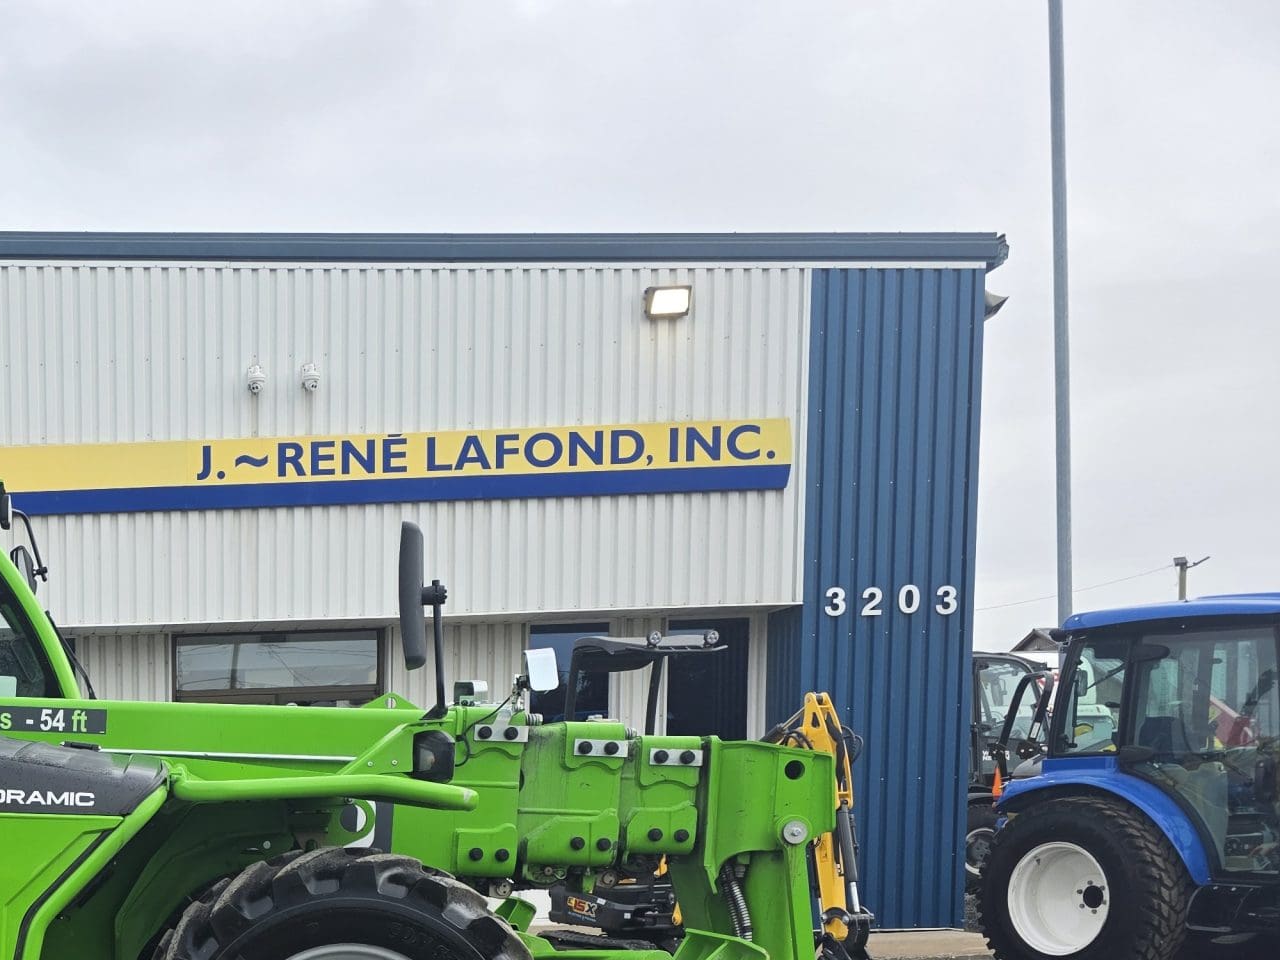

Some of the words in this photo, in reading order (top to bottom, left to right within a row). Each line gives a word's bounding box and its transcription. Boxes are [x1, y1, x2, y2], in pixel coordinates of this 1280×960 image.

[427, 428, 653, 472] LAFOND,
[669, 423, 776, 462] INC.
[40, 709, 65, 732] 54
[71, 710, 88, 732] ft
